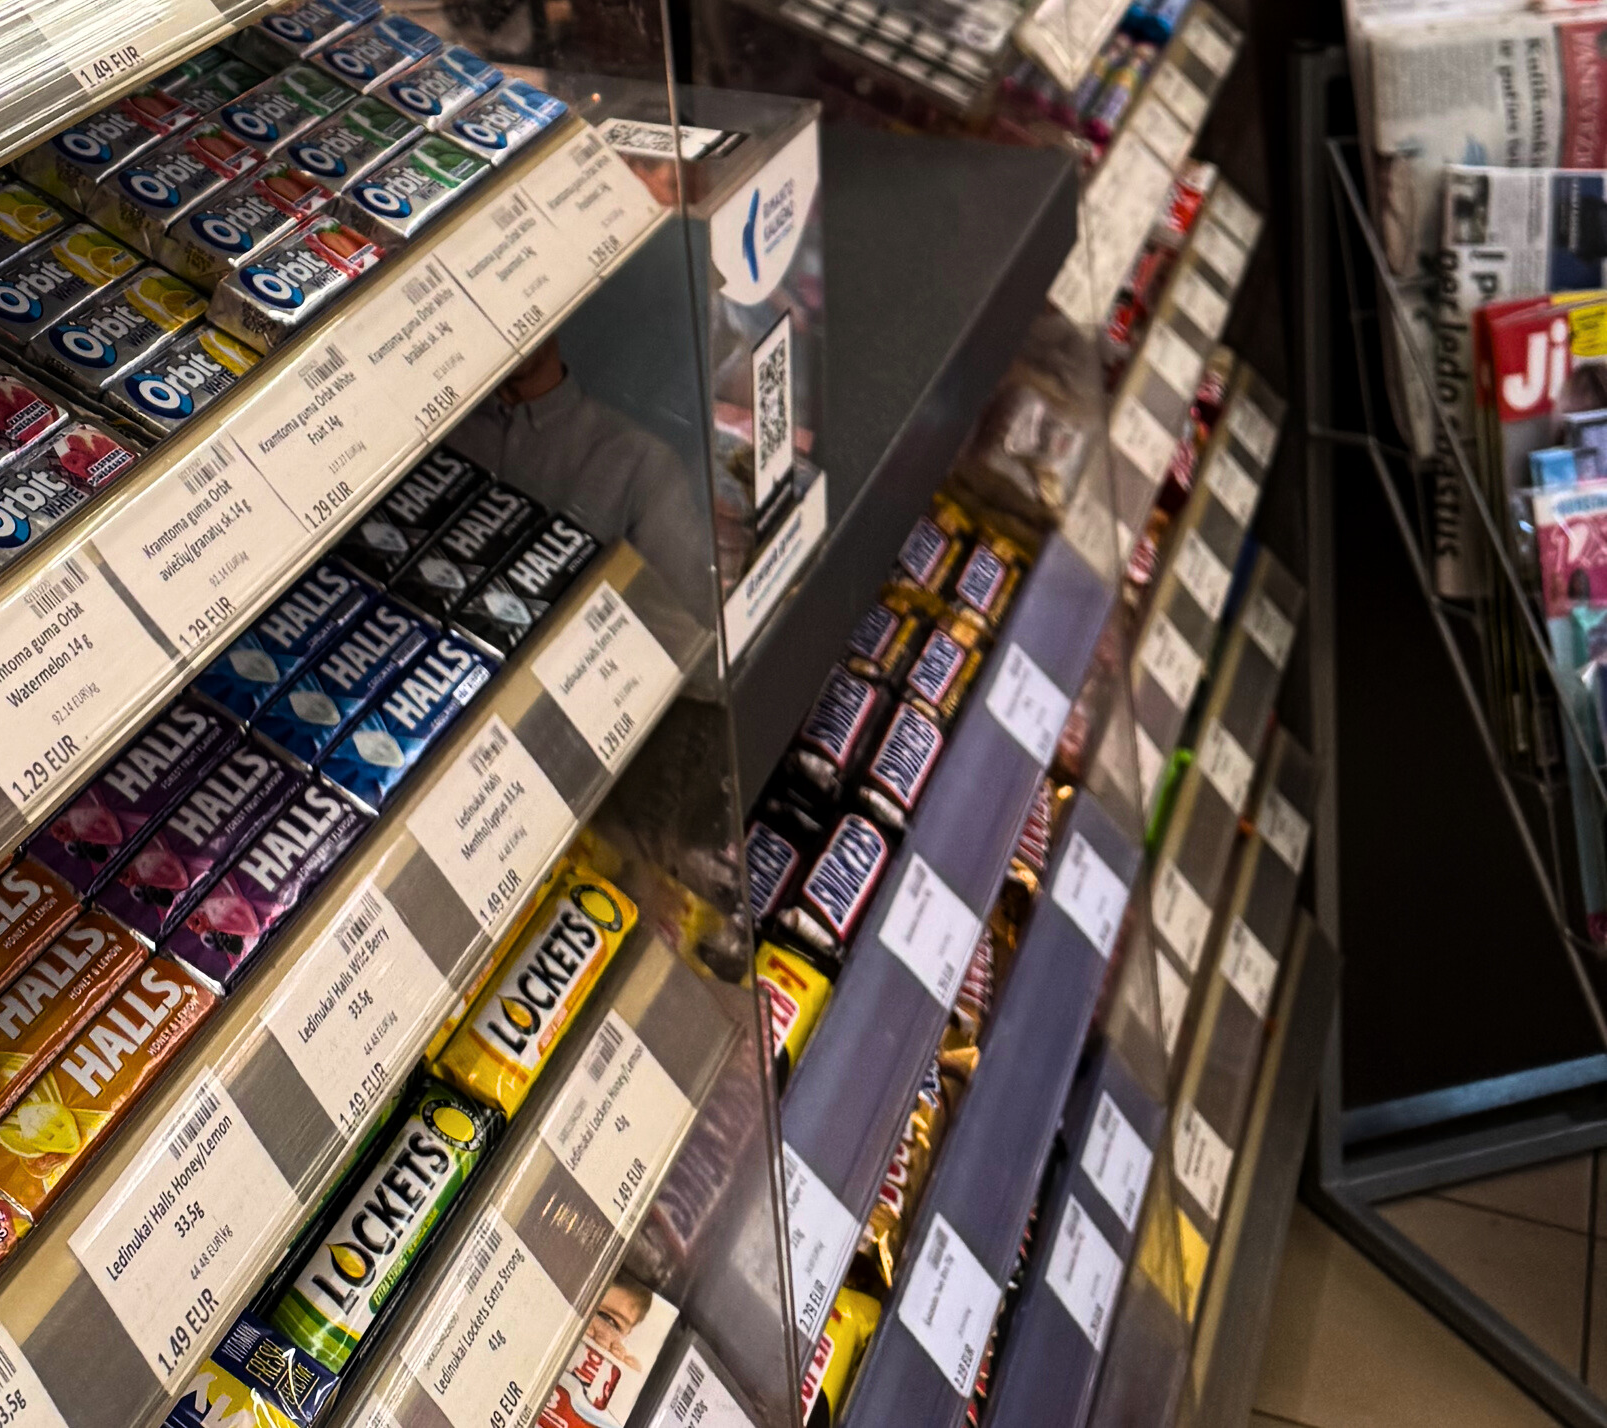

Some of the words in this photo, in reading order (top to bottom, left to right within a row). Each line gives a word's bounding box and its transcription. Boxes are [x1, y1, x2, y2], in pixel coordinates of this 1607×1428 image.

[137, 351, 224, 407] Orbit
[41, 487, 86, 521] WHITE
[304, 503, 330, 530] 1.29
[325, 481, 354, 511] EUR
[30, 630, 62, 664] guma
[57, 604, 86, 634] Orbit
[5, 649, 72, 710] Watermelon
[69, 639, 86, 659] 14
[83, 634, 94, 650] g
[12, 760, 50, 803] 1.29
[44, 734, 81, 770] EUR
[68, 974, 93, 1001] HONEY
[97, 943, 124, 970] LEMON
[297, 993, 339, 1045] Ledinukai
[332, 965, 356, 1000] Halls
[350, 945, 371, 976] Wild
[368, 922, 392, 951] Berry
[486, 906, 599, 1056] LOCKETS
[104, 1221, 154, 1282] Ledinukai
[149, 1187, 176, 1232] Halls
[172, 1114, 234, 1193] Honey/Lemon
[612, 1181, 634, 1213] 1.49
[627, 1157, 648, 1189] EUR
[173, 1200, 206, 1239] 33,5g
[311, 1127, 454, 1312] LOCKETS
[433, 1337, 472, 1398] Ledinukai
[465, 1297, 494, 1344] Lockets
[487, 1276, 507, 1306] Extra
[502, 1244, 527, 1283] Strong
[810, 1279, 826, 1306] EUR
[157, 1334, 193, 1376] 1.49
[186, 1287, 220, 1333] EUR
